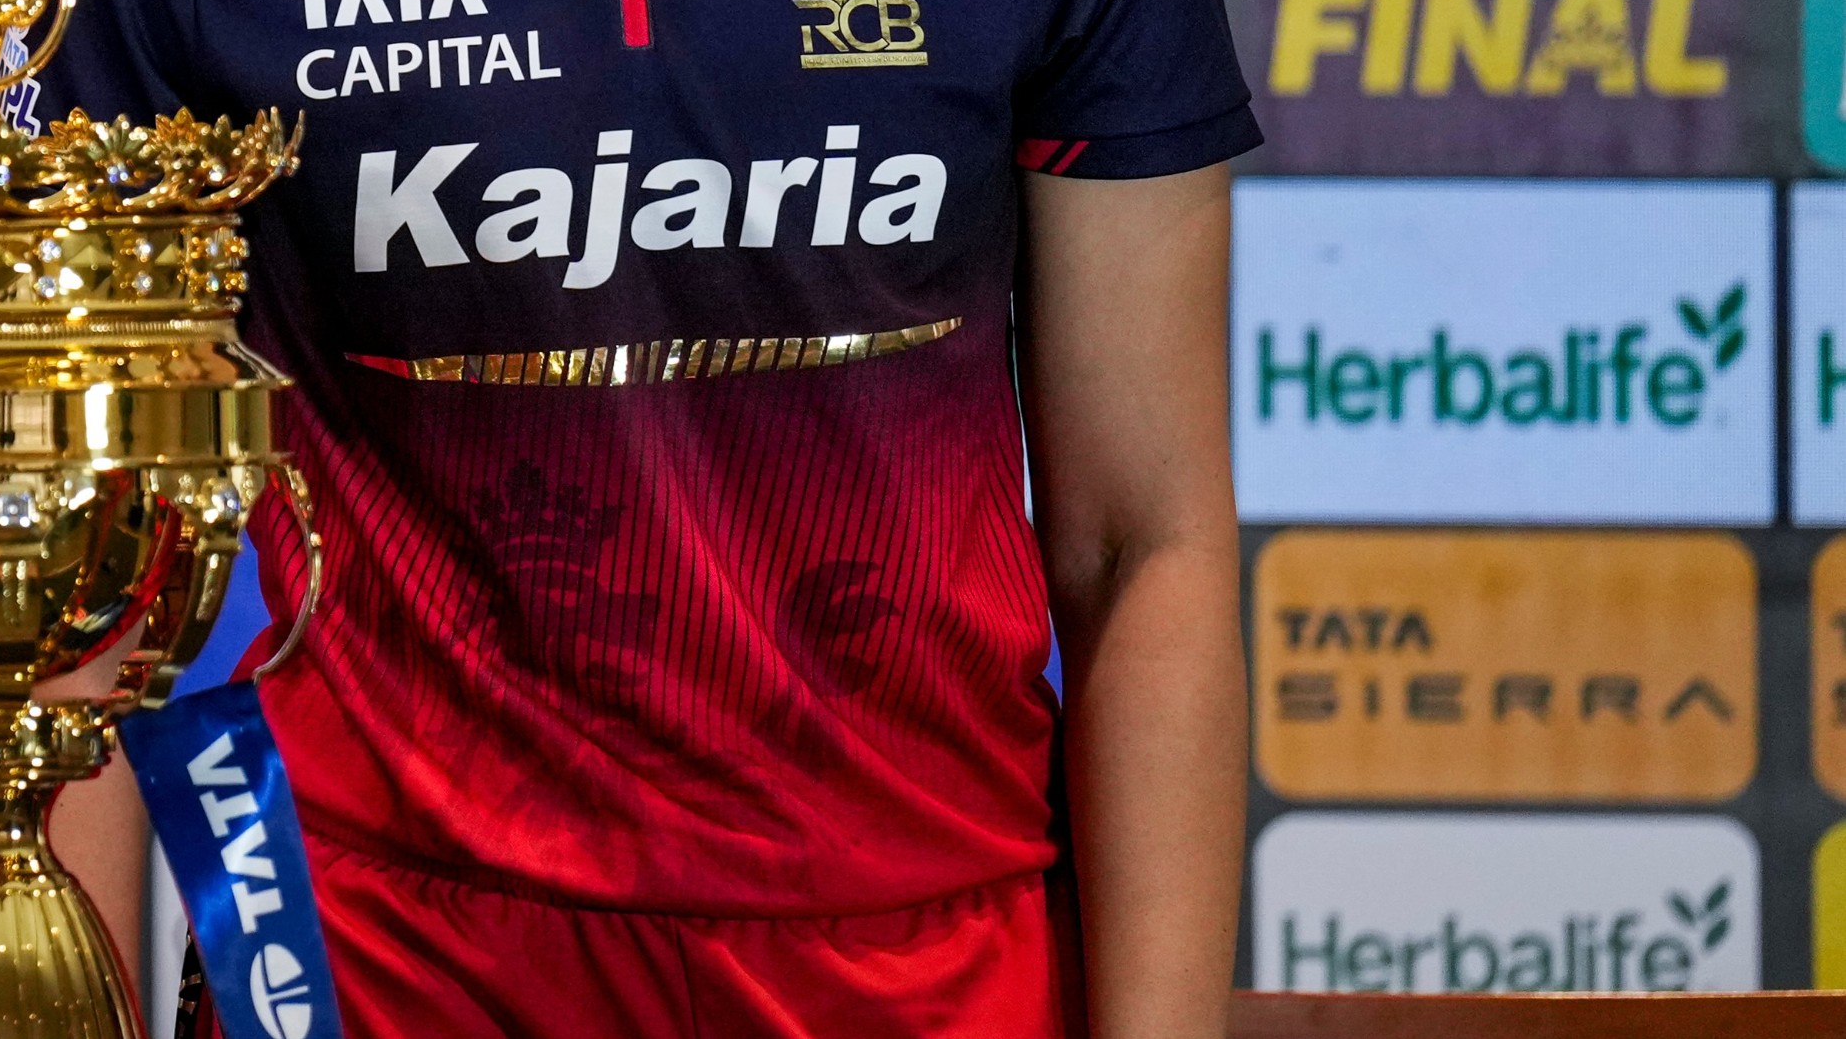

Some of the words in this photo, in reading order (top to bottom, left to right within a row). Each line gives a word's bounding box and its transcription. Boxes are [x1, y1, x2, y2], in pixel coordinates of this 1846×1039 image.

[296, 29, 562, 100] CAPITAL
[354, 124, 949, 290] Kajaria
[1255, 322, 1706, 429] Herbalife
[1279, 608, 1434, 653] TATA
[1275, 674, 1735, 724] SIERRA
[186, 731, 282, 935] TATA
[1280, 908, 1694, 992] Herbalife
